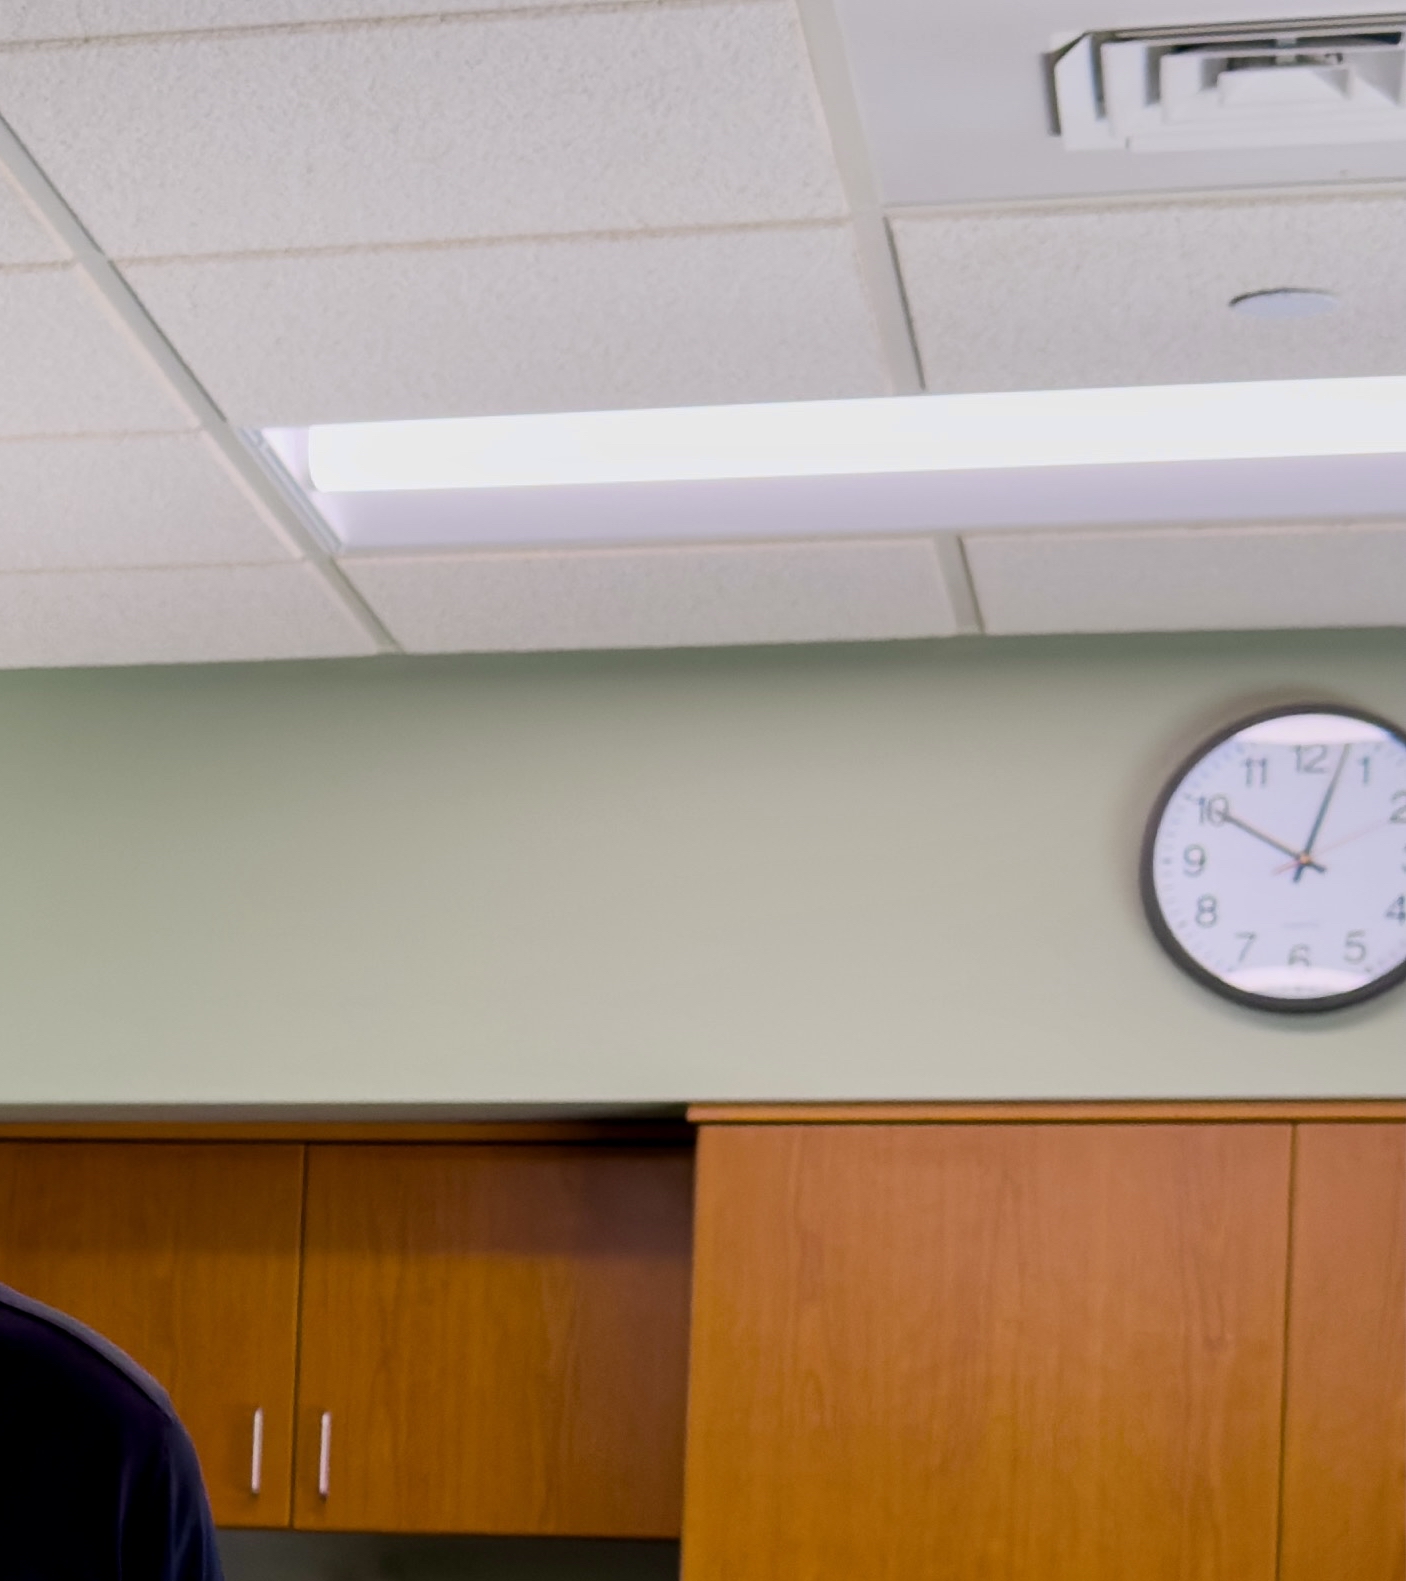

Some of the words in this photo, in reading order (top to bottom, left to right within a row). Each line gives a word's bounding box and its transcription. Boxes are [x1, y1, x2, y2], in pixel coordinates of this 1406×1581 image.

[1243, 757, 1269, 787] 11
[1292, 744, 1329, 774] 12
[1359, 757, 1371, 784] 1
[1196, 794, 1230, 827] 10
[1184, 844, 1206, 878] 9
[1195, 895, 1218, 928] 8
[1385, 894, 1406, 926] 4
[1235, 931, 1257, 962] 7
[1344, 929, 1368, 964] 5
